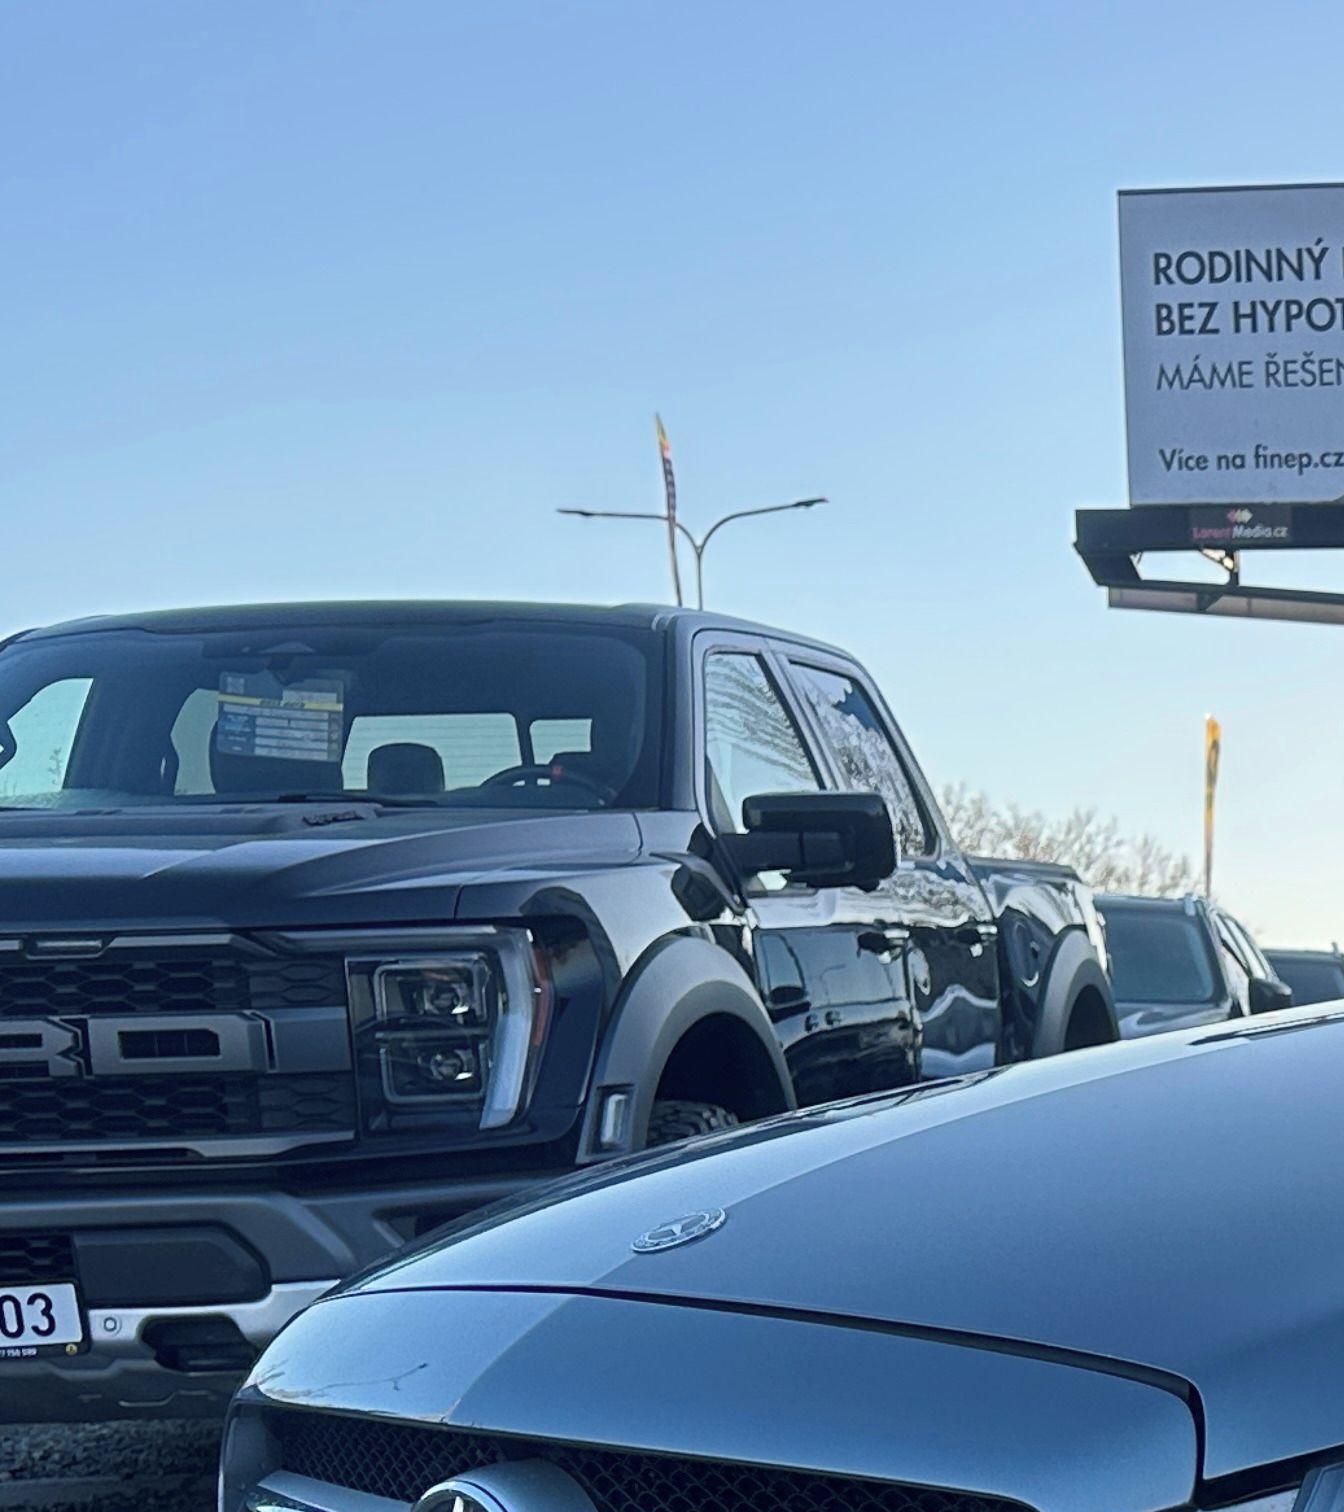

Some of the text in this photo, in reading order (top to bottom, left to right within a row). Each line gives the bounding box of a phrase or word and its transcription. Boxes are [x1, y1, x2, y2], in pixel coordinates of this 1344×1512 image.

[1153, 237, 1329, 285] RODINNÝ
[1155, 301, 1220, 336] BEZ
[1156, 355, 1254, 390] MÁME
[1158, 449, 1208, 472] Více
[1216, 455, 1246, 471] na
[0, 1293, 56, 1339] 03
